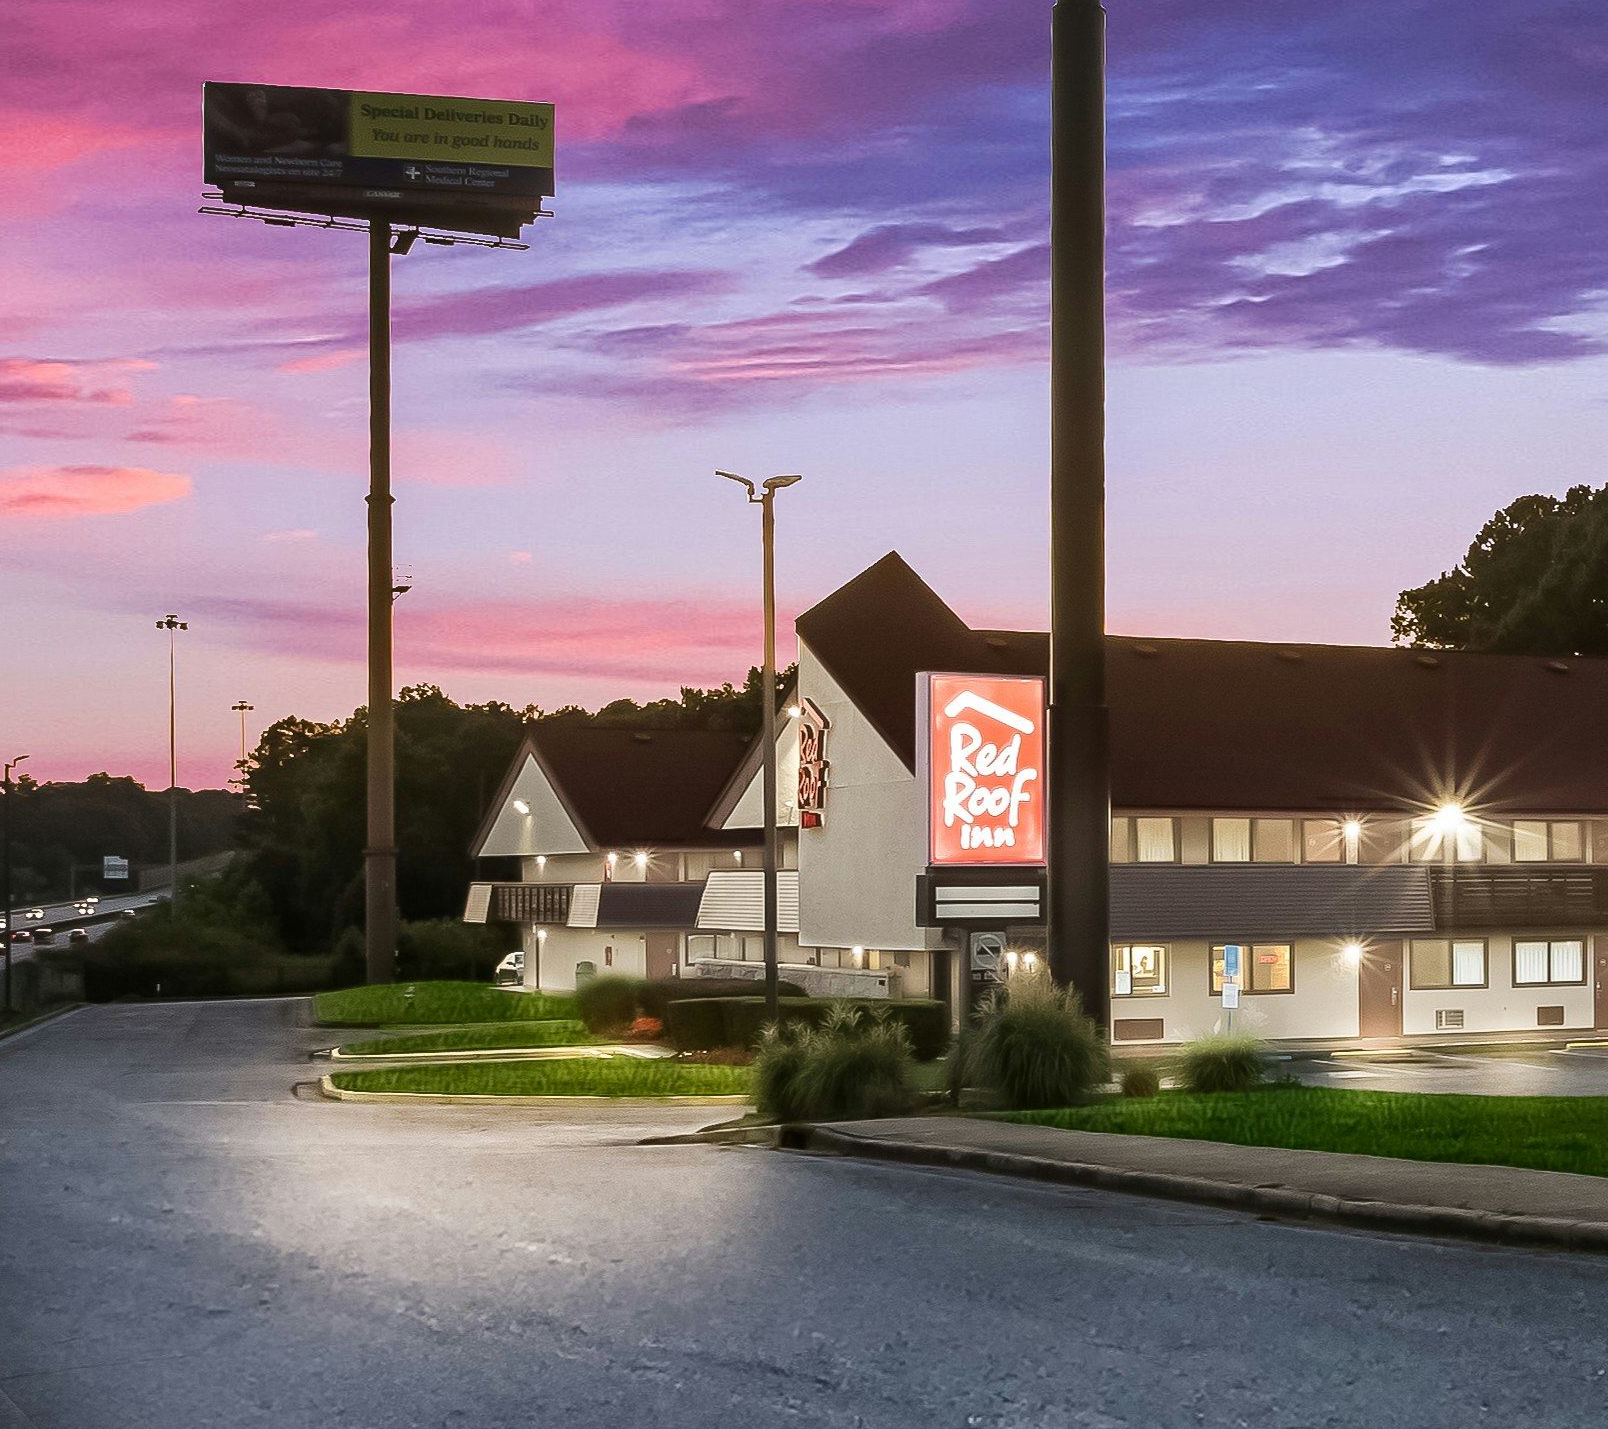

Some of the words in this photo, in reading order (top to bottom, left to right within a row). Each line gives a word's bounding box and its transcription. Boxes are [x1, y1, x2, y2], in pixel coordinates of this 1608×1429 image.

[361, 104, 419, 119] Special
[424, 108, 504, 124] Deliveries
[508, 113, 548, 130] Daily
[372, 128, 399, 142] You
[403, 133, 430, 144] are
[434, 132, 449, 145] in
[451, 134, 490, 149] good
[493, 135, 541, 151] hands
[215, 154, 252, 164] Women
[253, 156, 272, 164] and
[320, 158, 343, 168] Care
[425, 165, 467, 175] Southern
[799, 724, 823, 763] Red
[950, 722, 1022, 777] Red
[798, 760, 828, 809] Roof
[943, 769, 1037, 827] Roof
